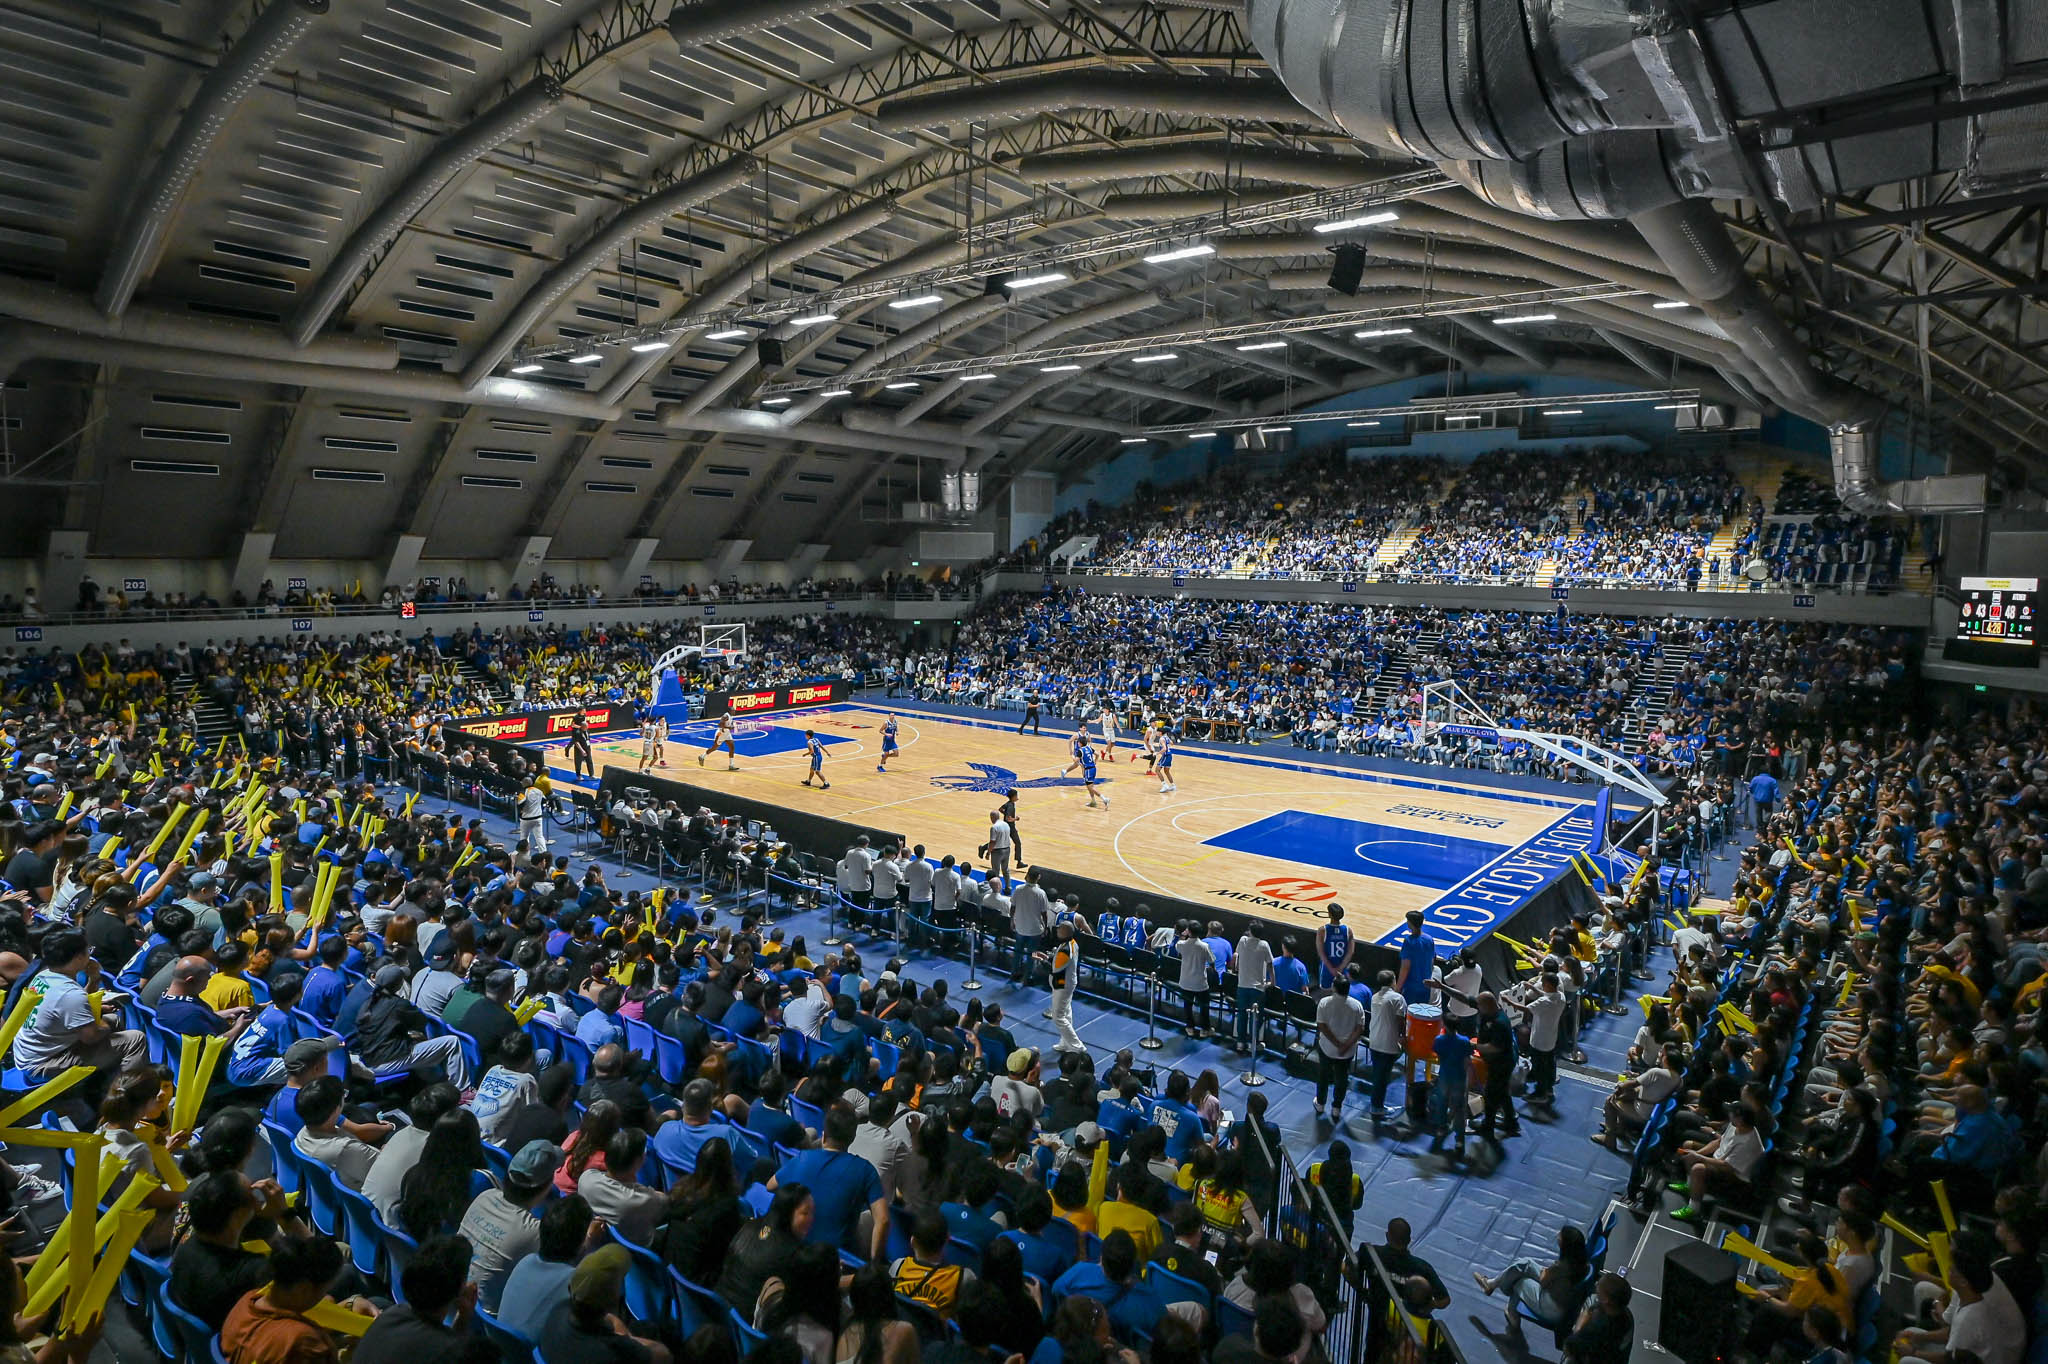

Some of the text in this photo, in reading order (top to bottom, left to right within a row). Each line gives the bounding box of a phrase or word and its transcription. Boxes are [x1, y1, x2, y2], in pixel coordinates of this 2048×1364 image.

[125, 581, 146, 589] 202
[289, 580, 306, 588] 203
[1552, 590, 1568, 598] 114
[1795, 597, 1814, 606] 115
[294, 621, 311, 629] 107
[17, 630, 41, 640] 106
[729, 694, 774, 711] TopBreed
[790, 688, 831, 704] TopBreed
[550, 711, 609, 732] Topreed
[1534, 816, 1594, 852] BLUE
[1458, 848, 1573, 906] EAGLE
[1101, 924, 1116, 941] 15
[1124, 929, 1137, 945] 14
[1330, 941, 1345, 957] 18
